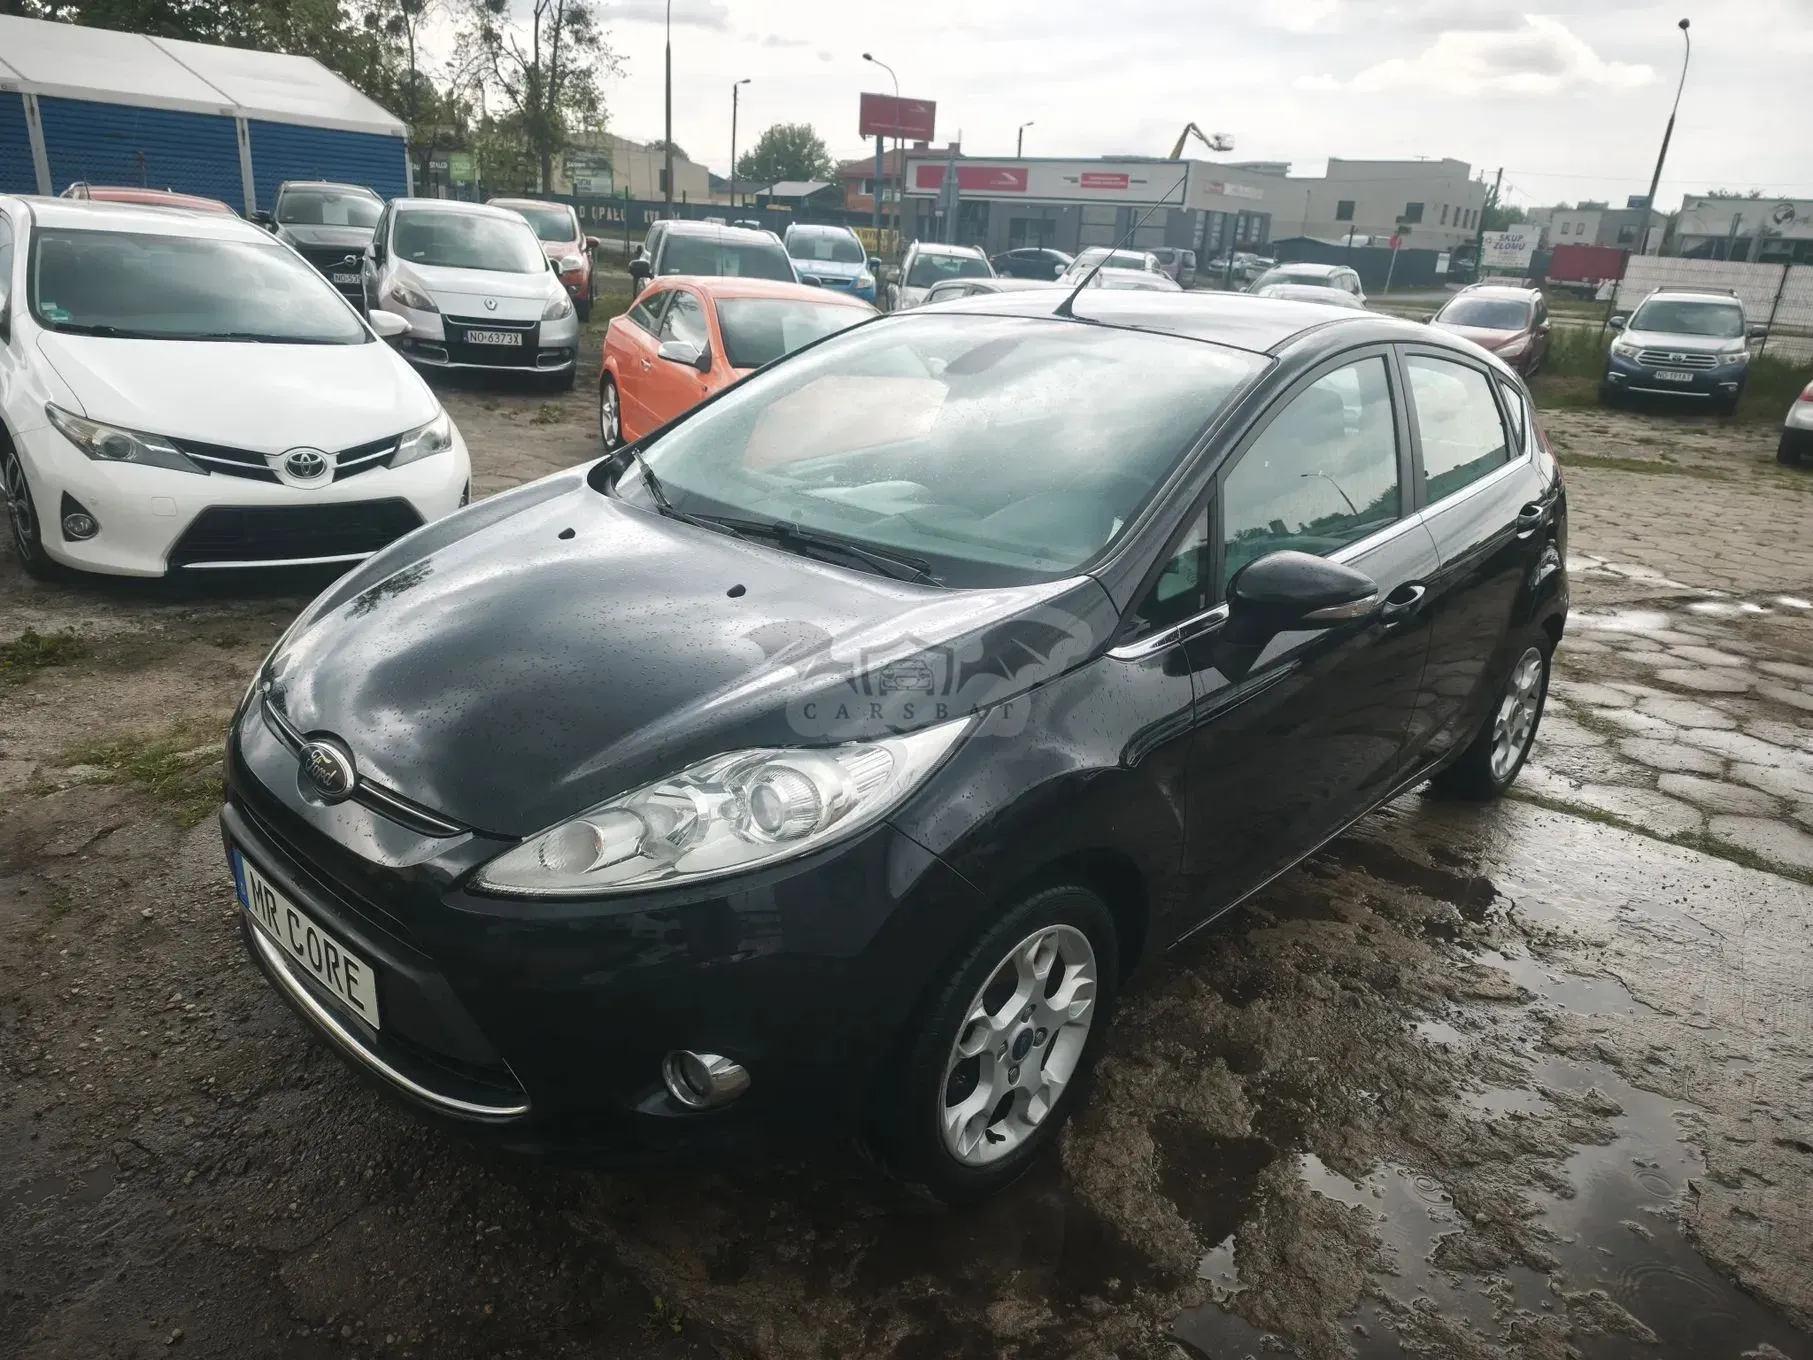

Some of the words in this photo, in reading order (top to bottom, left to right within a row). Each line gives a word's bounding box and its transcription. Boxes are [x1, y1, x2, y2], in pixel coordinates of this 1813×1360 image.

[1500, 233, 1524, 242] SKUP
[305, 749, 338, 789] Ford
[249, 870, 281, 937] MR
[286, 907, 365, 1011] CORE
